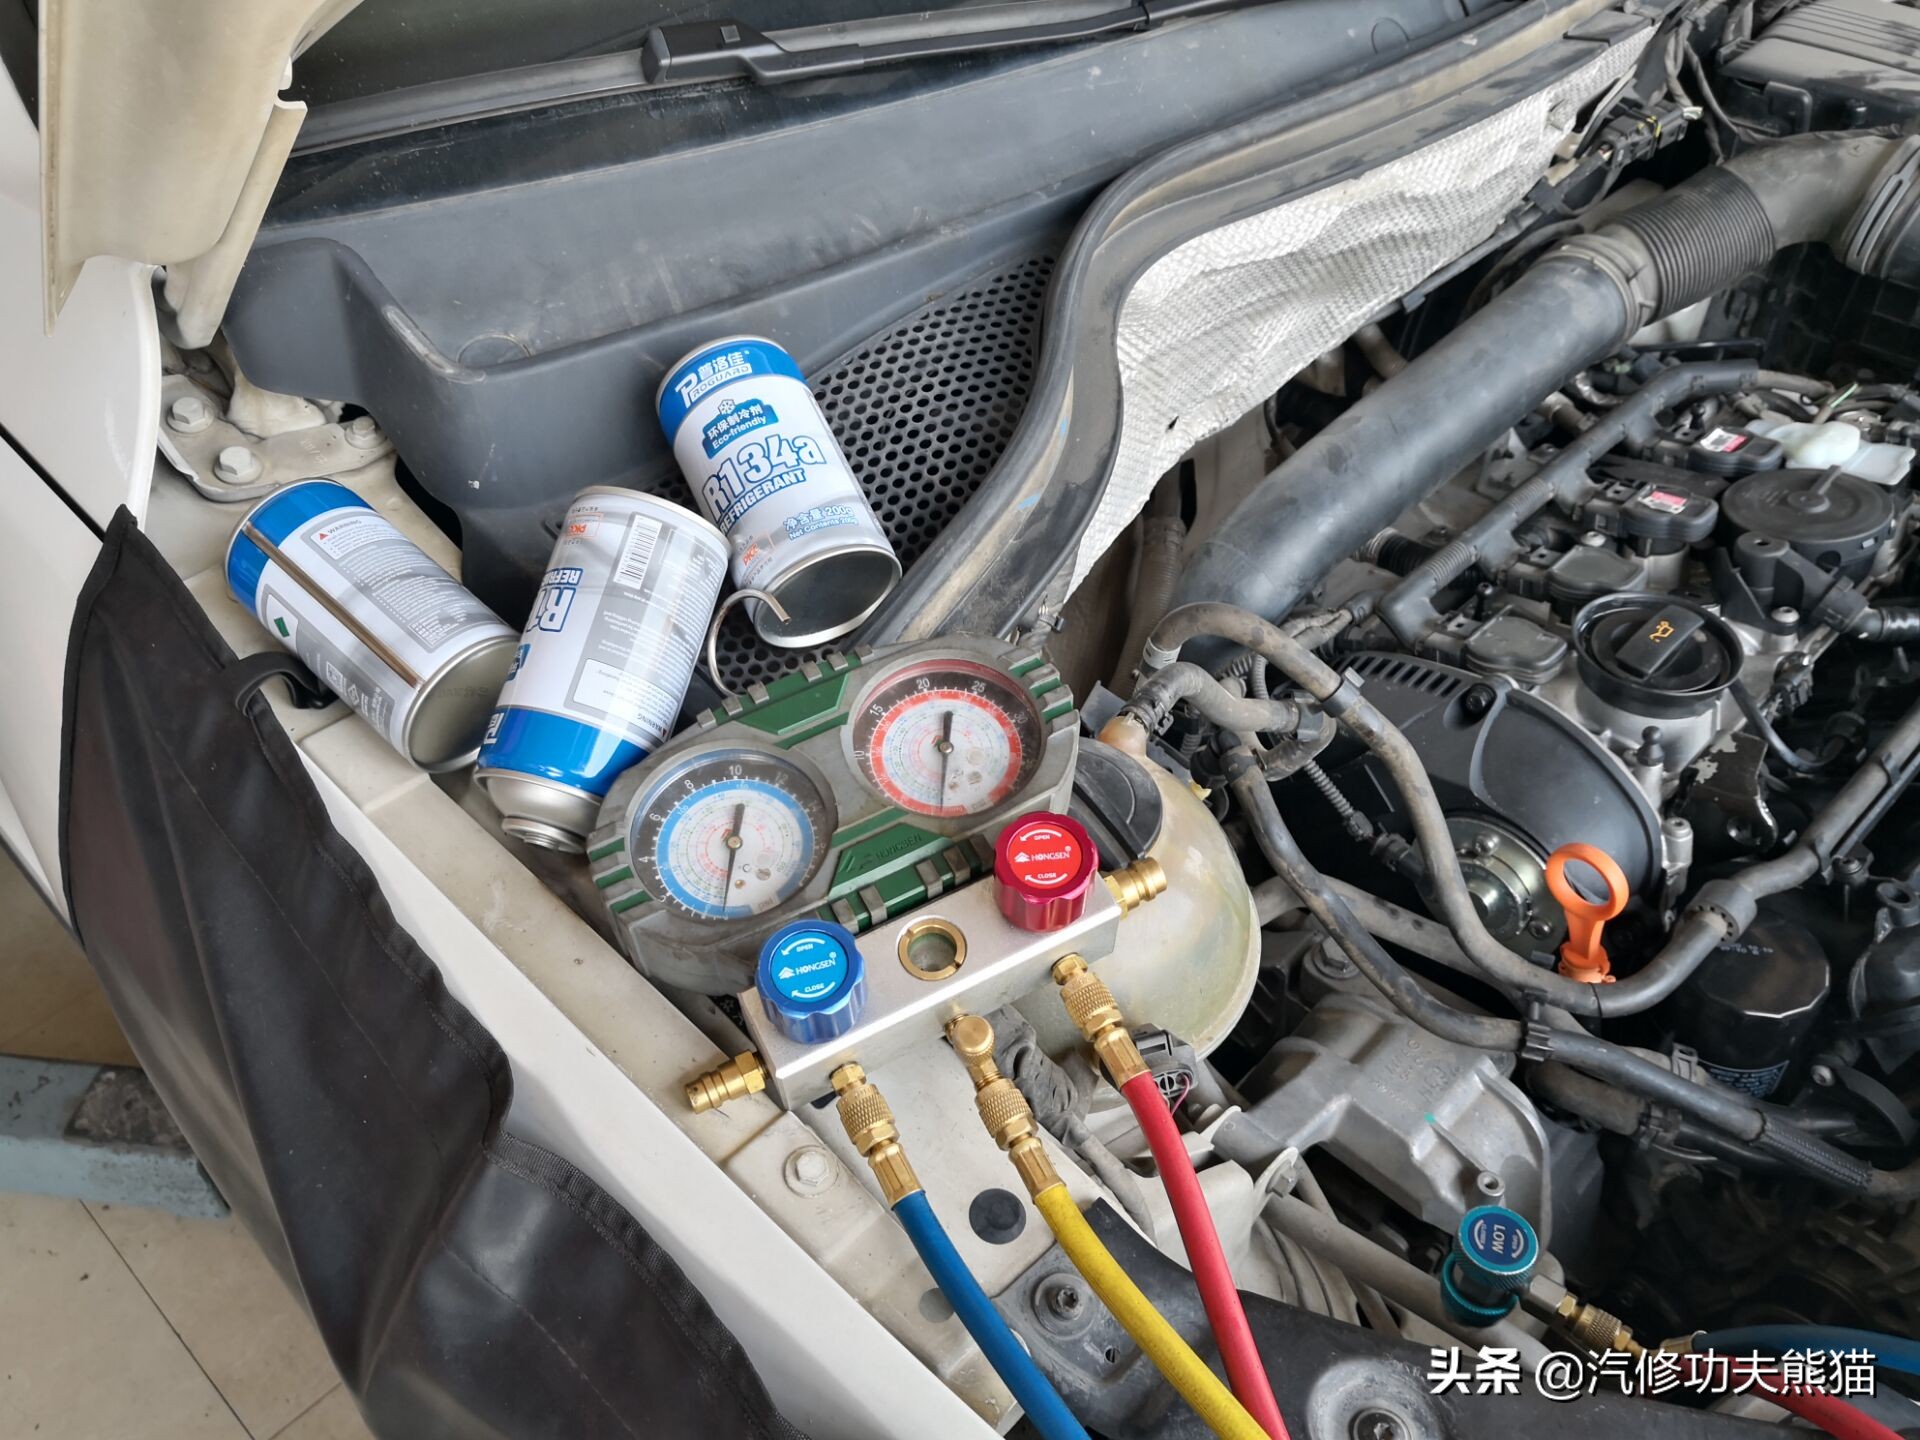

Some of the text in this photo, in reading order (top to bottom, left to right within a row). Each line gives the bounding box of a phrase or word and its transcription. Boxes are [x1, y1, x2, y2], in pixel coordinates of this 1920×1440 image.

[698, 351, 745, 380] 普洛佳
[674, 363, 753, 409] PROGUARD
[707, 404, 763, 440] 环保制冷剂
[712, 416, 767, 450] Eco-friendly
[702, 434, 827, 524] R134a
[783, 507, 825, 531] 净含量
[789, 529, 804, 540] Net
[916, 677, 930, 690] 20
[971, 680, 986, 693] 25
[869, 703, 884, 716] 15
[728, 764, 743, 776] 10
[684, 779, 694, 790] 8
[649, 813, 661, 822] 6
[1031, 851, 1070, 862] HONGSEN
[796, 943, 814, 953] OPEN
[795, 958, 836, 976] HONGSEN
[804, 982, 825, 993] CLOSE
[1492, 1224, 1506, 1254] LOW
